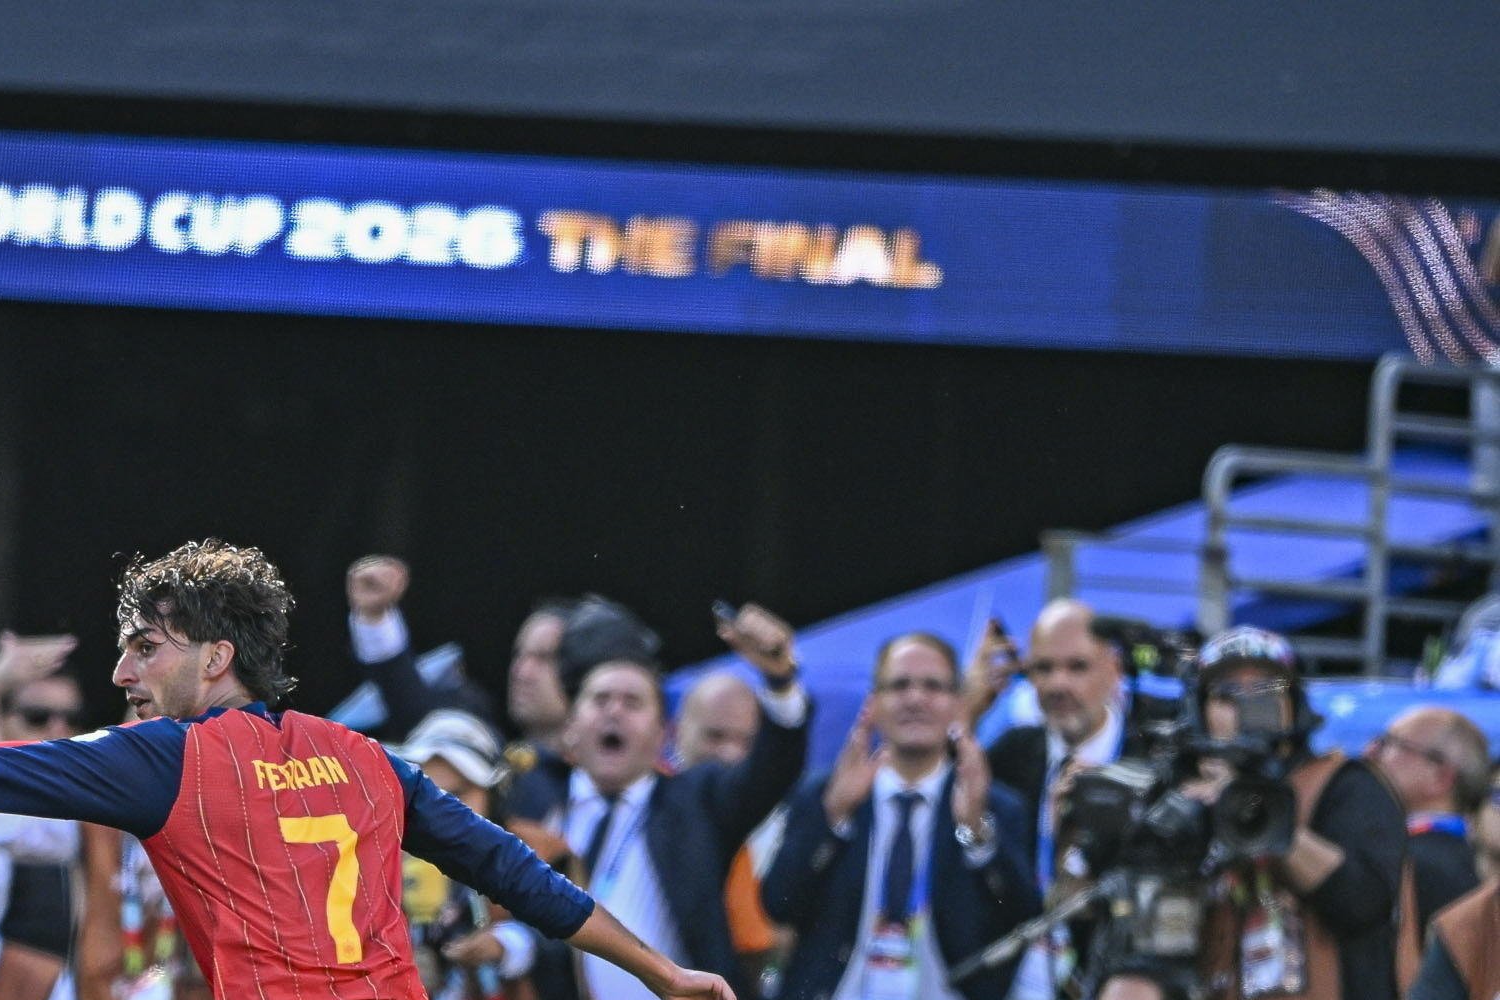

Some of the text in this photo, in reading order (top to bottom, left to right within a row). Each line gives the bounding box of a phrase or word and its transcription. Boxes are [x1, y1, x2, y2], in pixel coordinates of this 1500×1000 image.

[147, 189, 282, 257] CUP
[283, 196, 524, 270] 2026
[536, 207, 698, 278] THE
[707, 218, 944, 290] FINAL
[251, 756, 349, 790] FERRAN
[278, 814, 363, 964] 7
